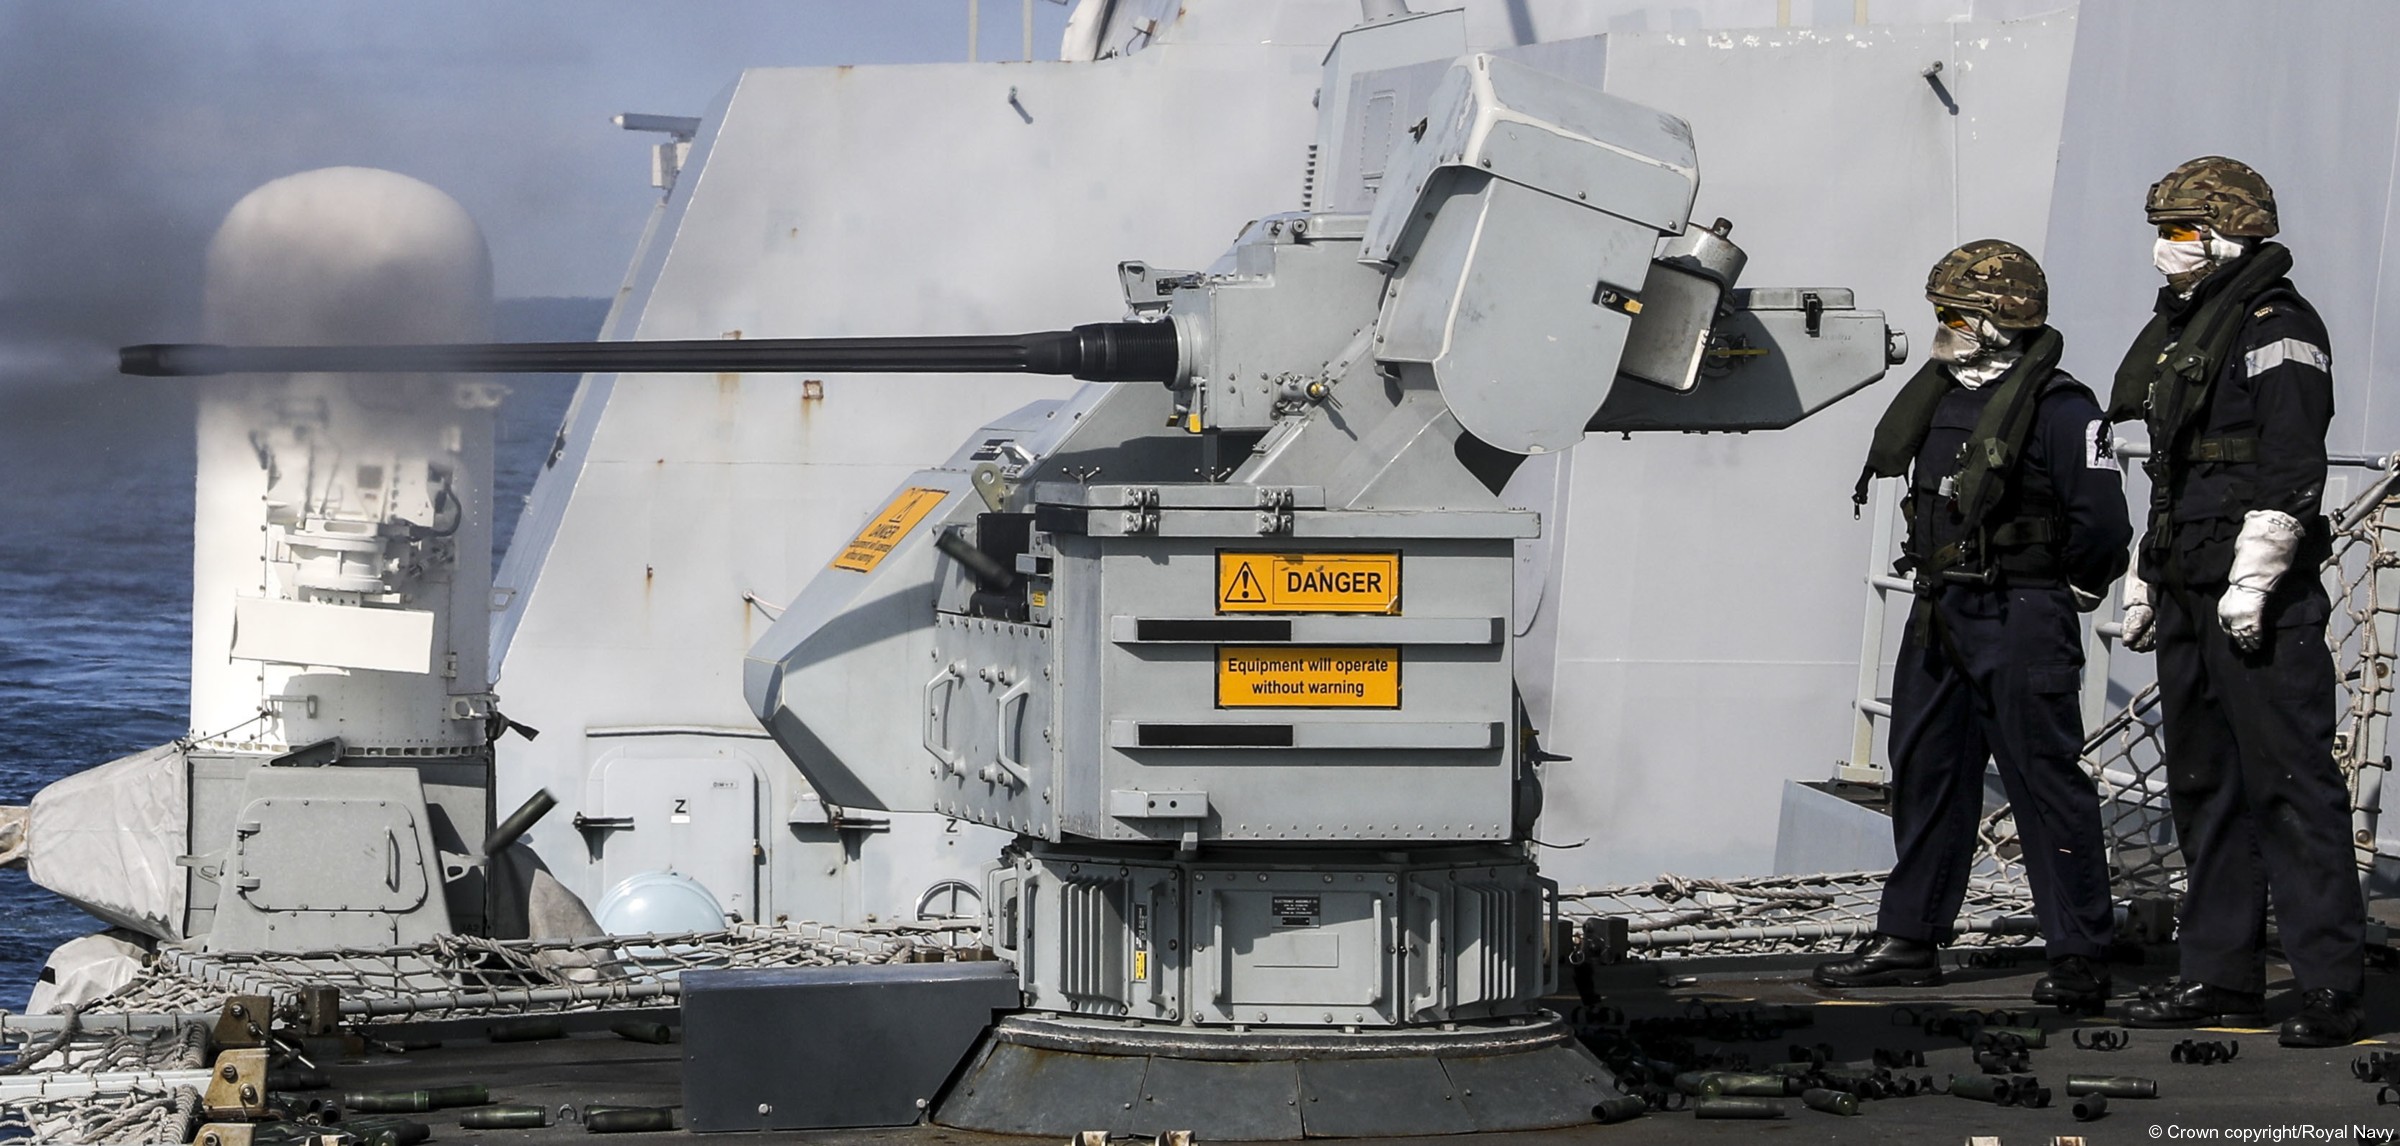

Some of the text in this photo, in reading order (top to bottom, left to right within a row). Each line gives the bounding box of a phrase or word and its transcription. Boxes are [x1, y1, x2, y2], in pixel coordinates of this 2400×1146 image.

[1287, 572, 1382, 593] DANGER
[1228, 658, 1389, 675] Equipment will operate
[1252, 680, 1364, 697] without warning
[675, 799, 687, 814] Z
[946, 818, 958, 833] Z
